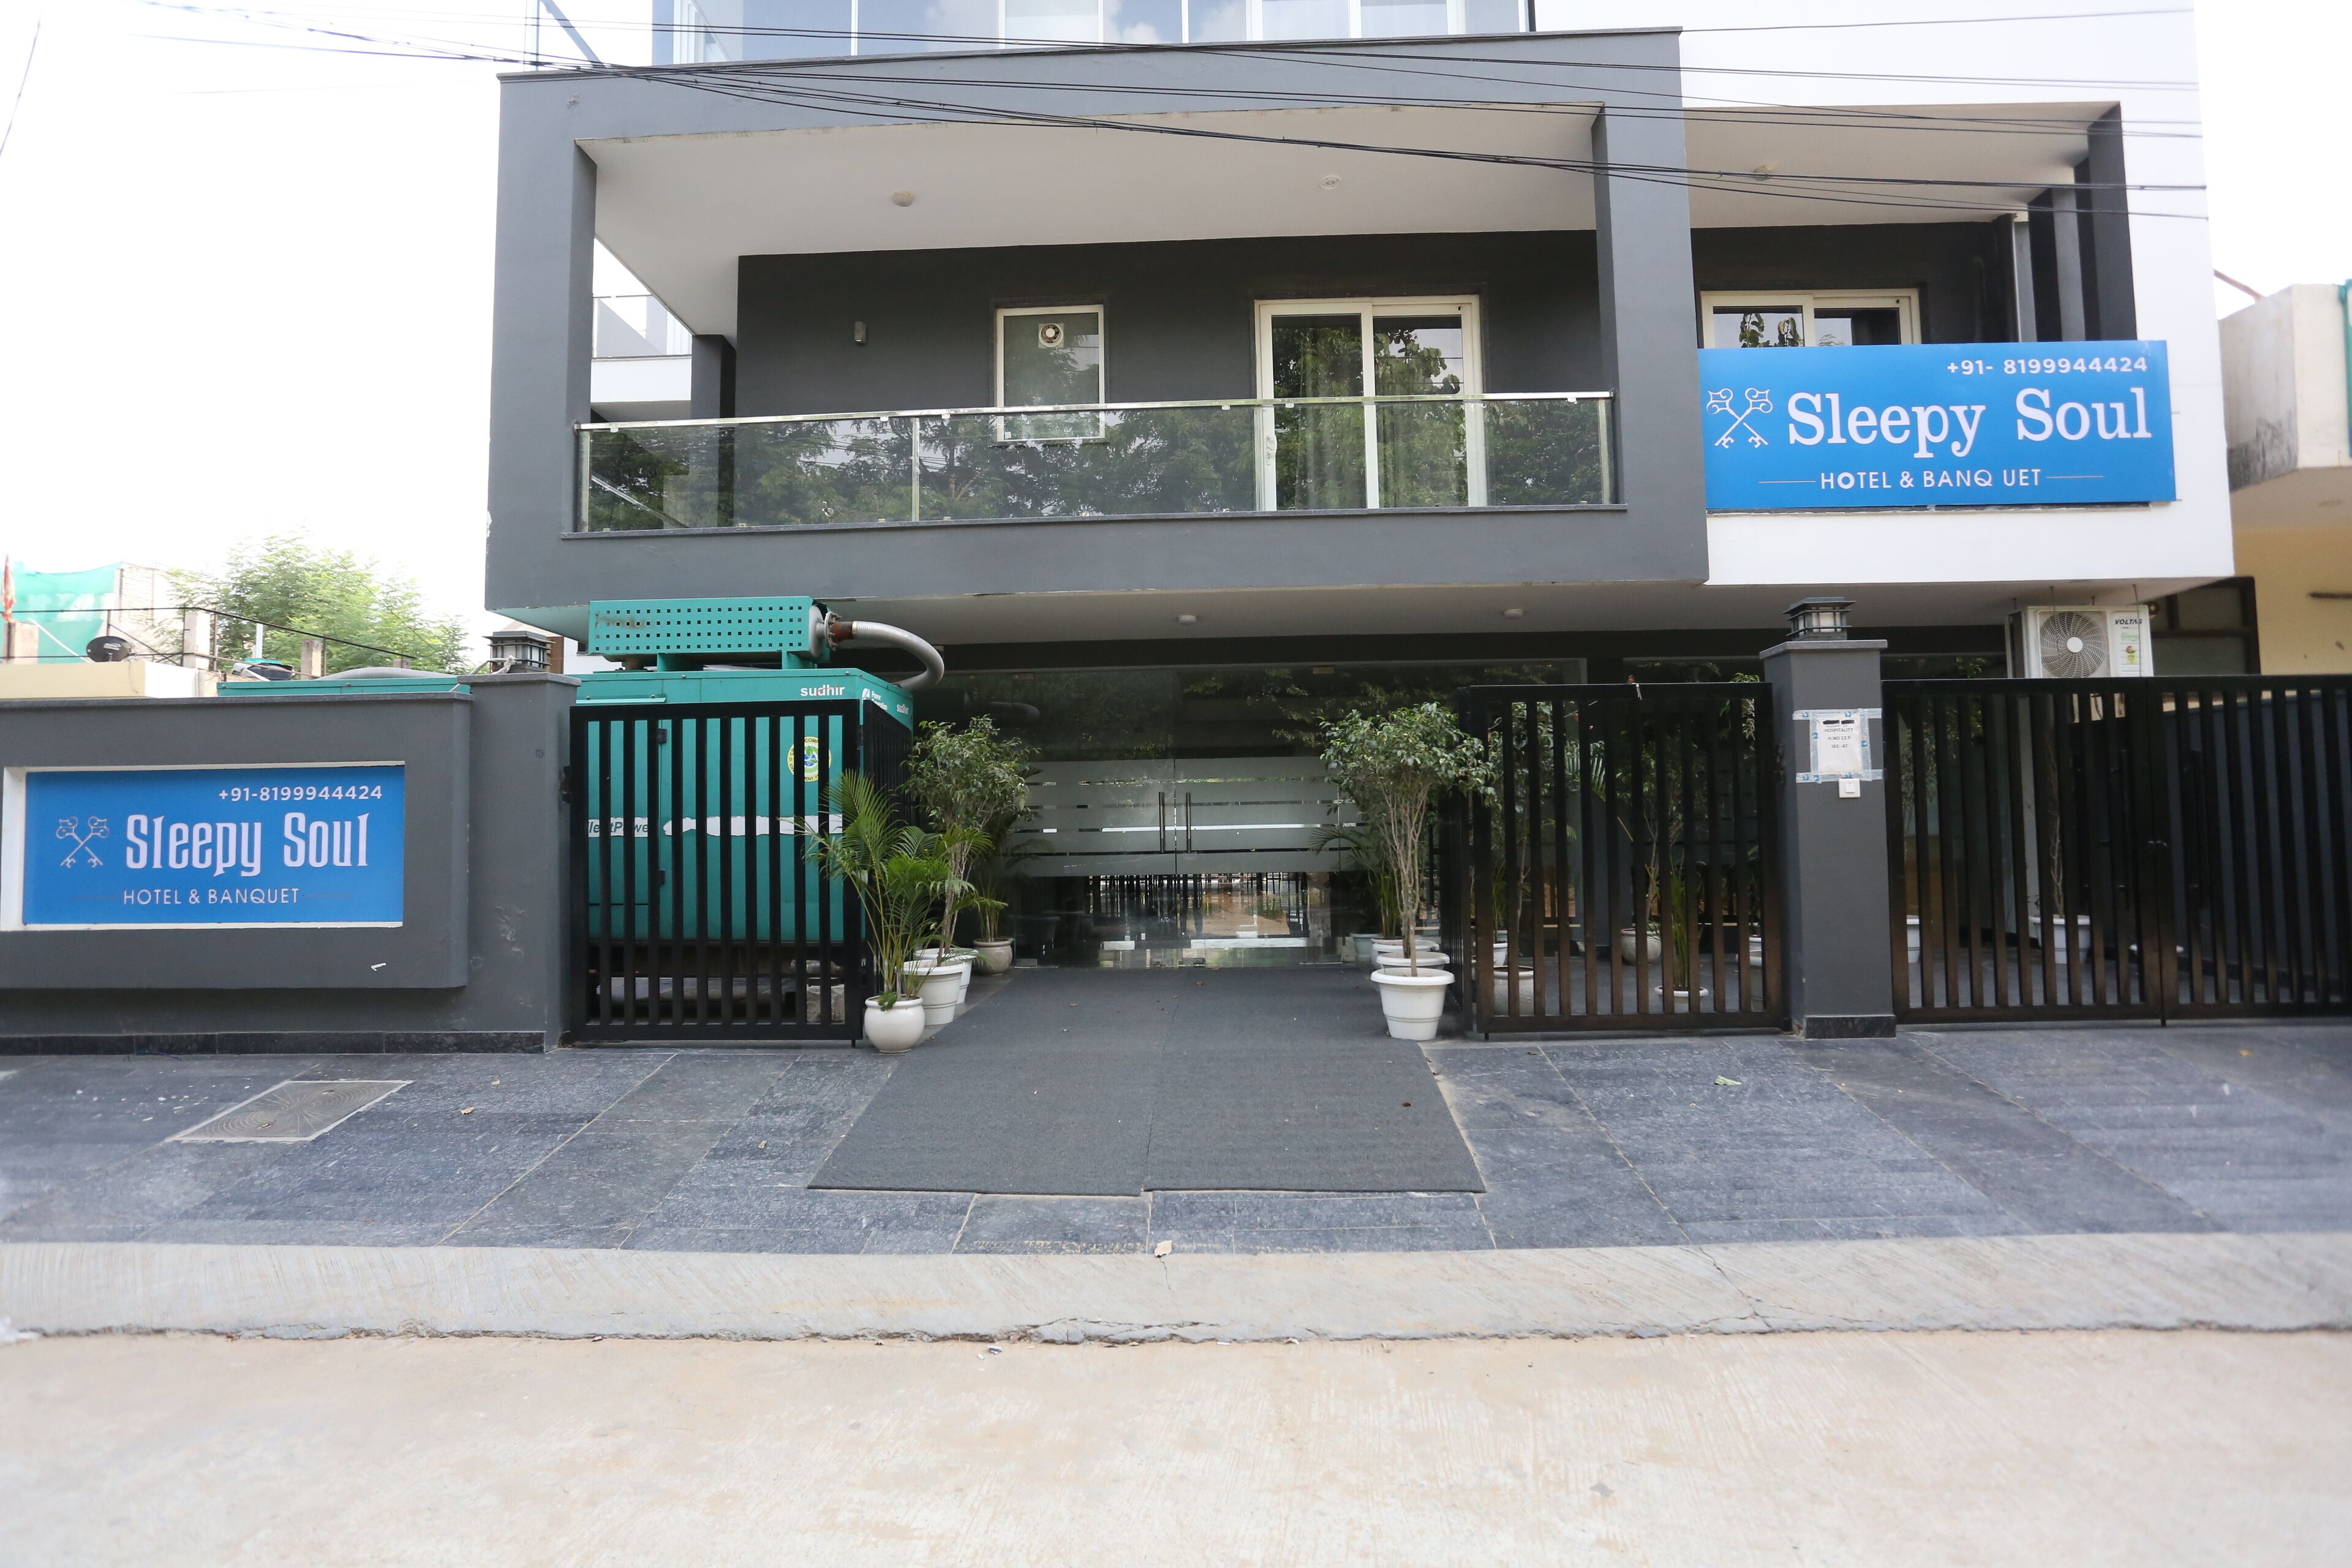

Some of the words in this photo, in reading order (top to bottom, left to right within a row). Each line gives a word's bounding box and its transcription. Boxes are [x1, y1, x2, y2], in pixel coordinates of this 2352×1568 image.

[2003, 356, 2147, 374] 8199944424
[1787, 392, 1986, 458] Sleepy
[2016, 387, 2152, 442] Soul
[1821, 470, 1891, 489] HOTEL
[1899, 471, 1914, 488] &
[801, 684, 845, 696] sudhir
[219, 785, 382, 802] +91-8199944424
[126, 814, 262, 877] Sleepy
[284, 812, 369, 868] Soul
[124, 889, 181, 905] HOTEL
[189, 889, 200, 904] &
[208, 888, 299, 904] BANQUET
